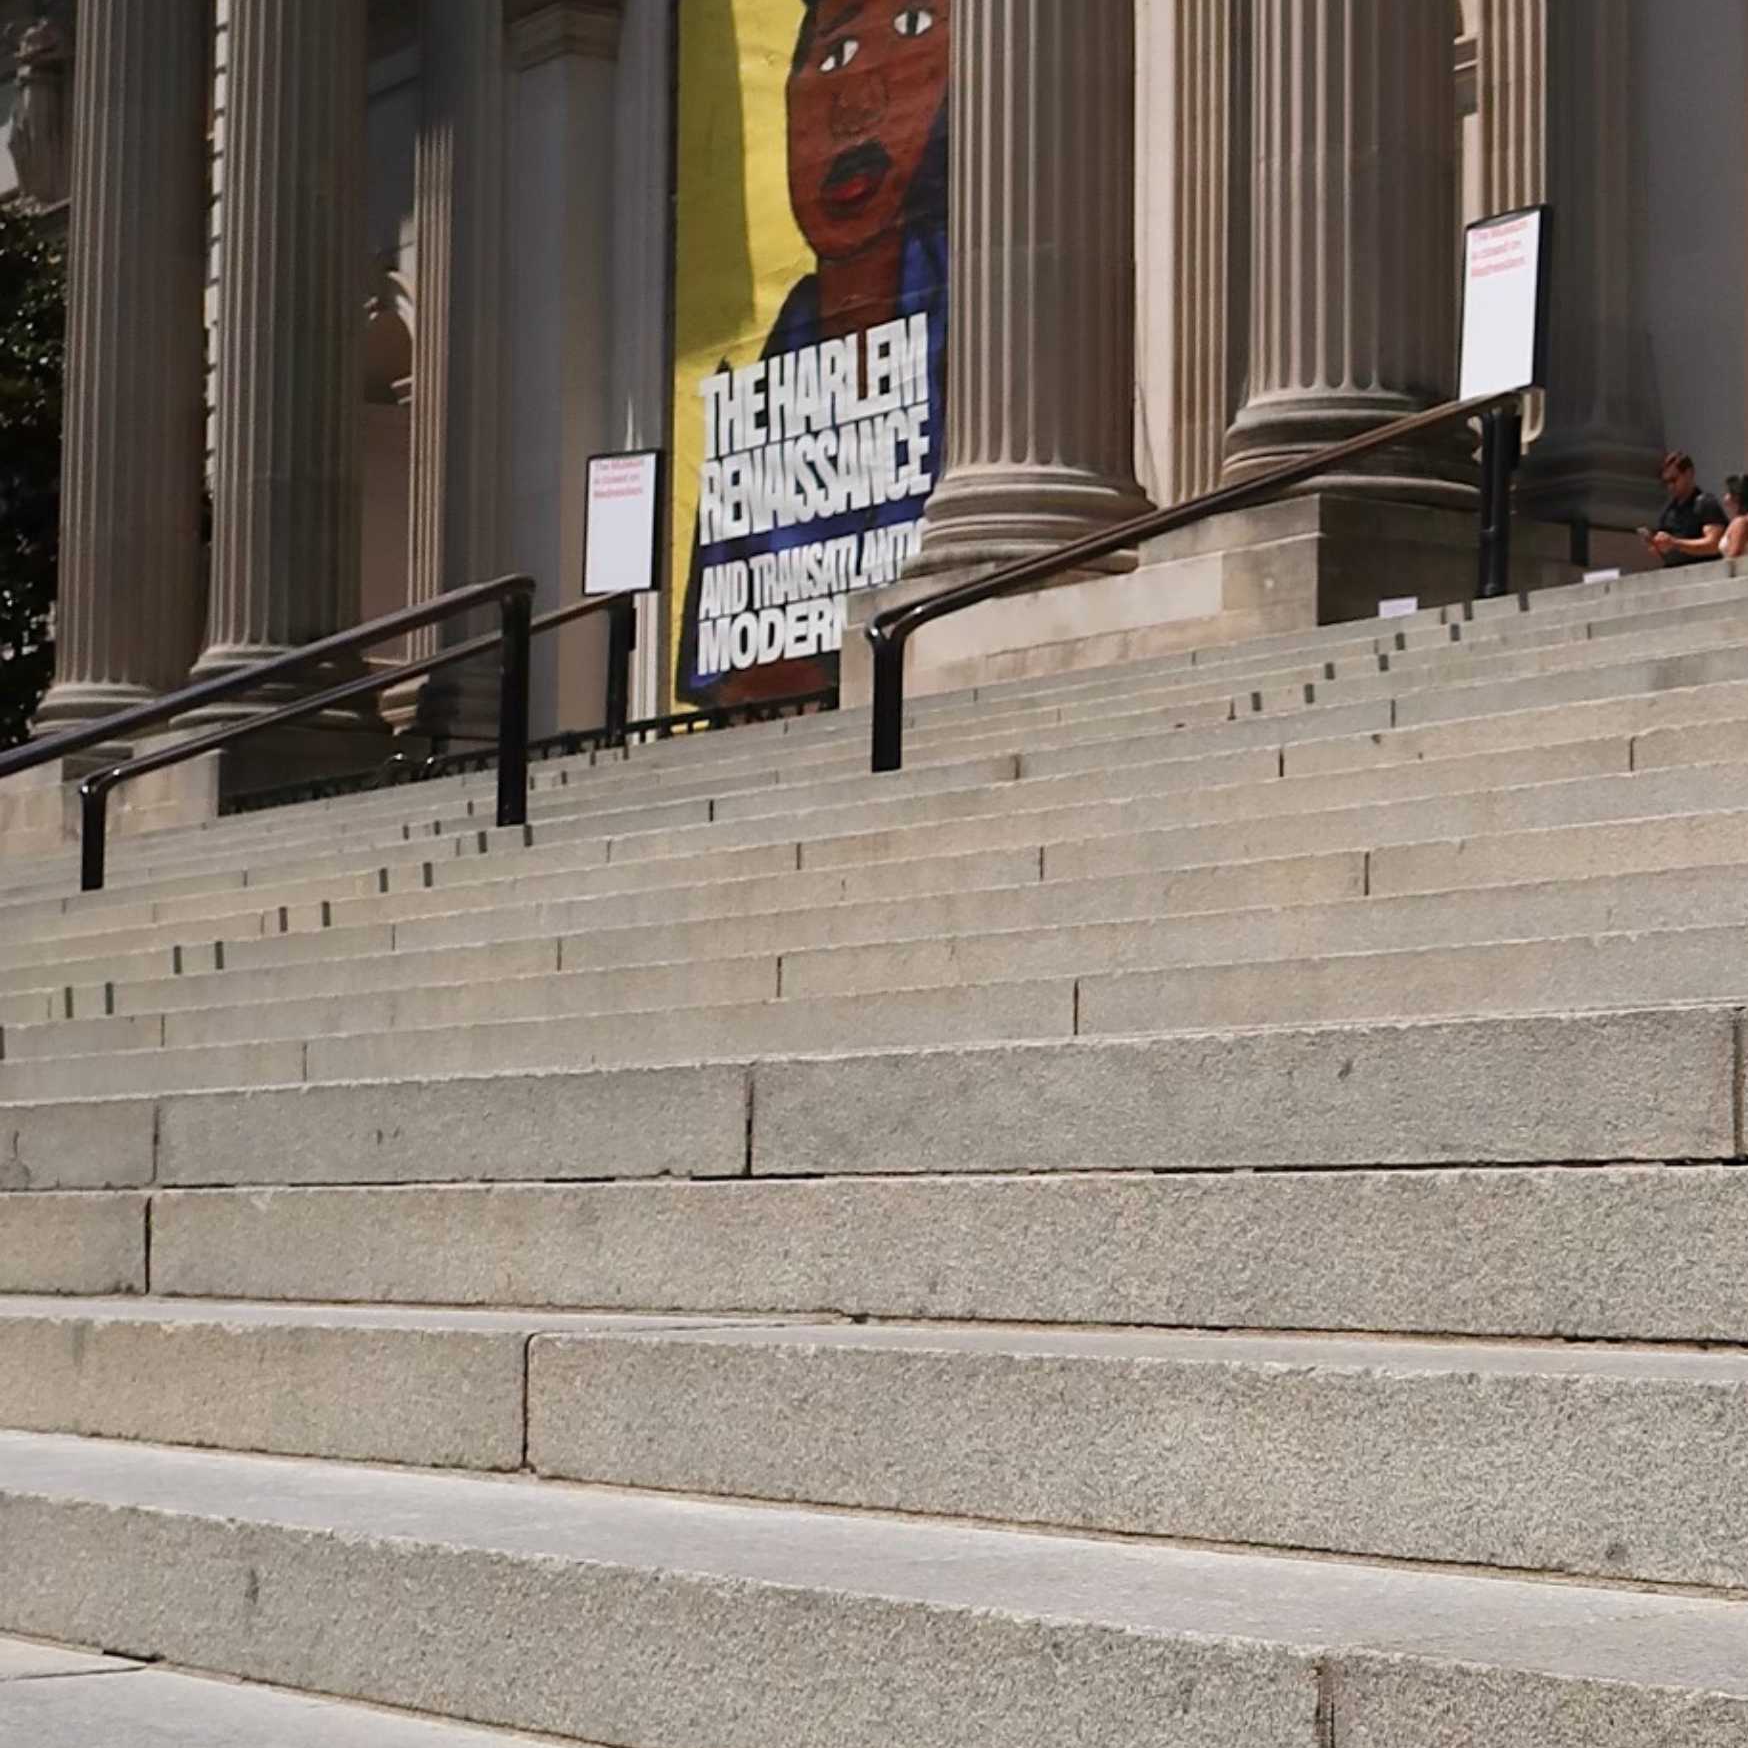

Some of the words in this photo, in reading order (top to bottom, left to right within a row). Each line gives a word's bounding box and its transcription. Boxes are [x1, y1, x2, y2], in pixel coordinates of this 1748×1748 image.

[701, 361, 768, 460] THE
[767, 312, 928, 443] HARLEM
[700, 404, 932, 547] RENAISSANCE
[699, 559, 749, 620] AND
